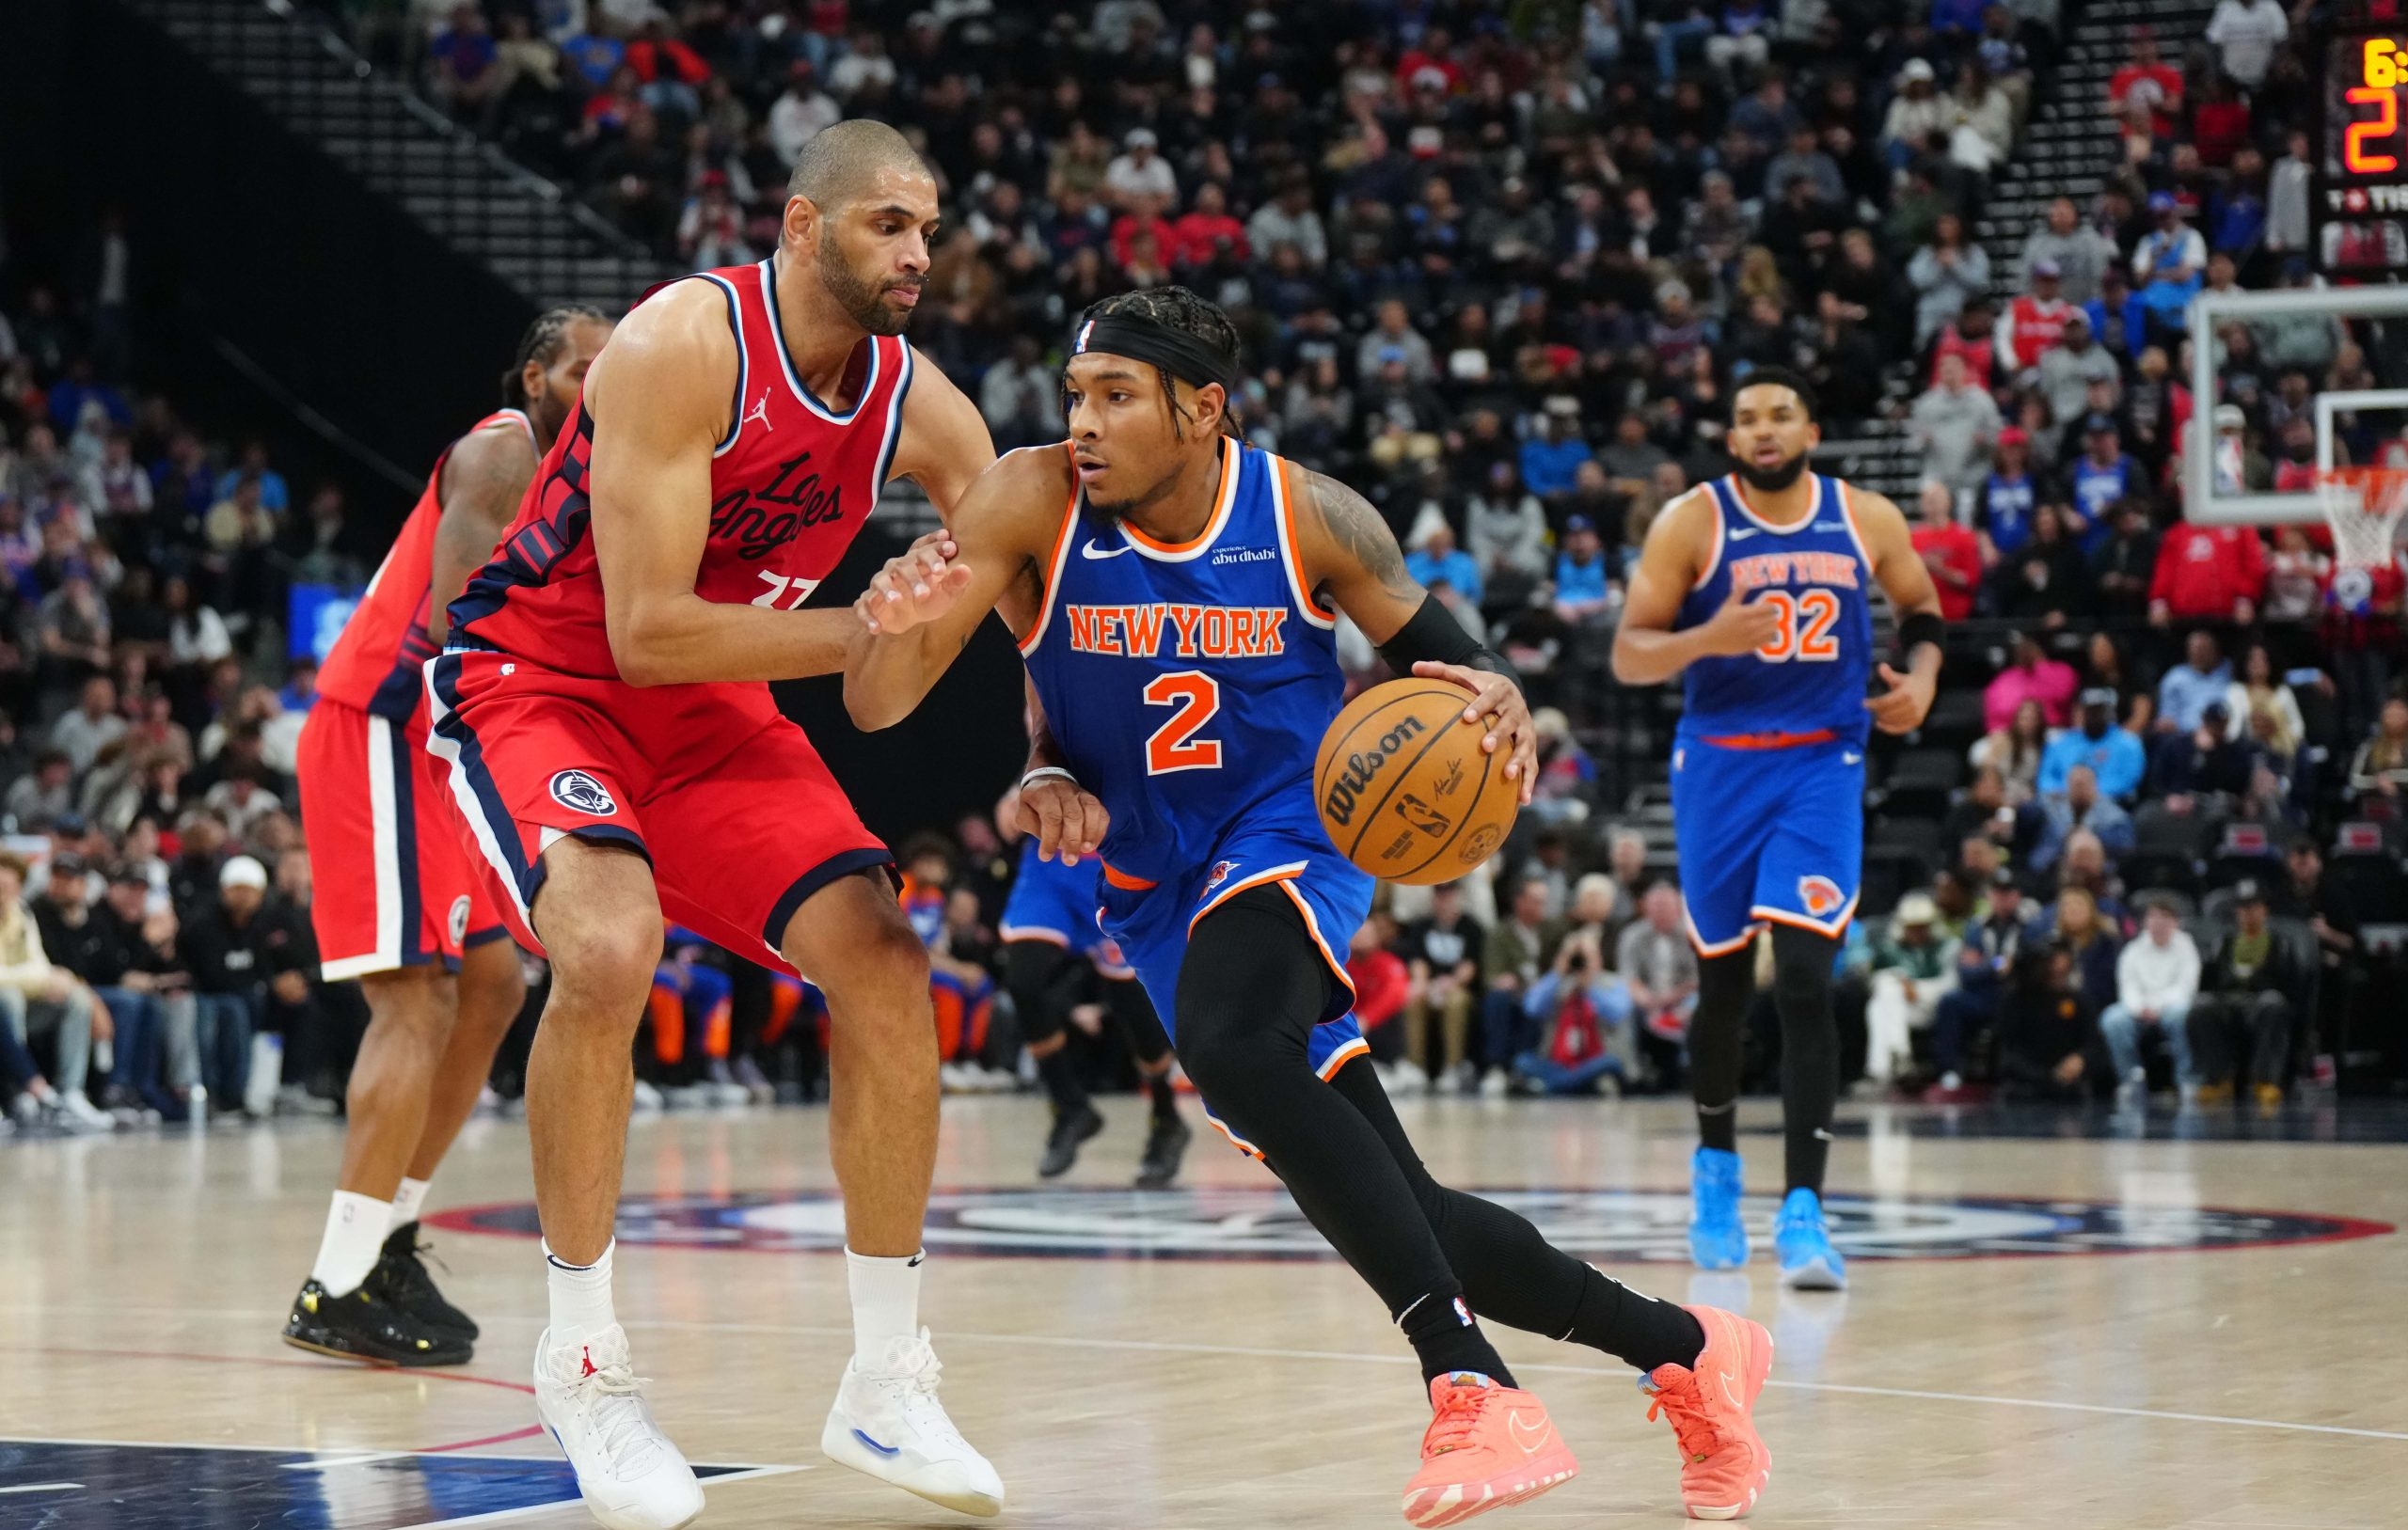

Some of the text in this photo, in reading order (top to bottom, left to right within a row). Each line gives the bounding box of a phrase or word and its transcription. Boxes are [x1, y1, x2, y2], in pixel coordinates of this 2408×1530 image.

[755, 451, 820, 506] Lo
[1212, 545, 1247, 554] experience
[1212, 553, 1238, 565] abu
[1066, 602, 1288, 658] NEW YORK
[1143, 670, 1223, 776] 2
[1325, 716, 1426, 828] Wilson
